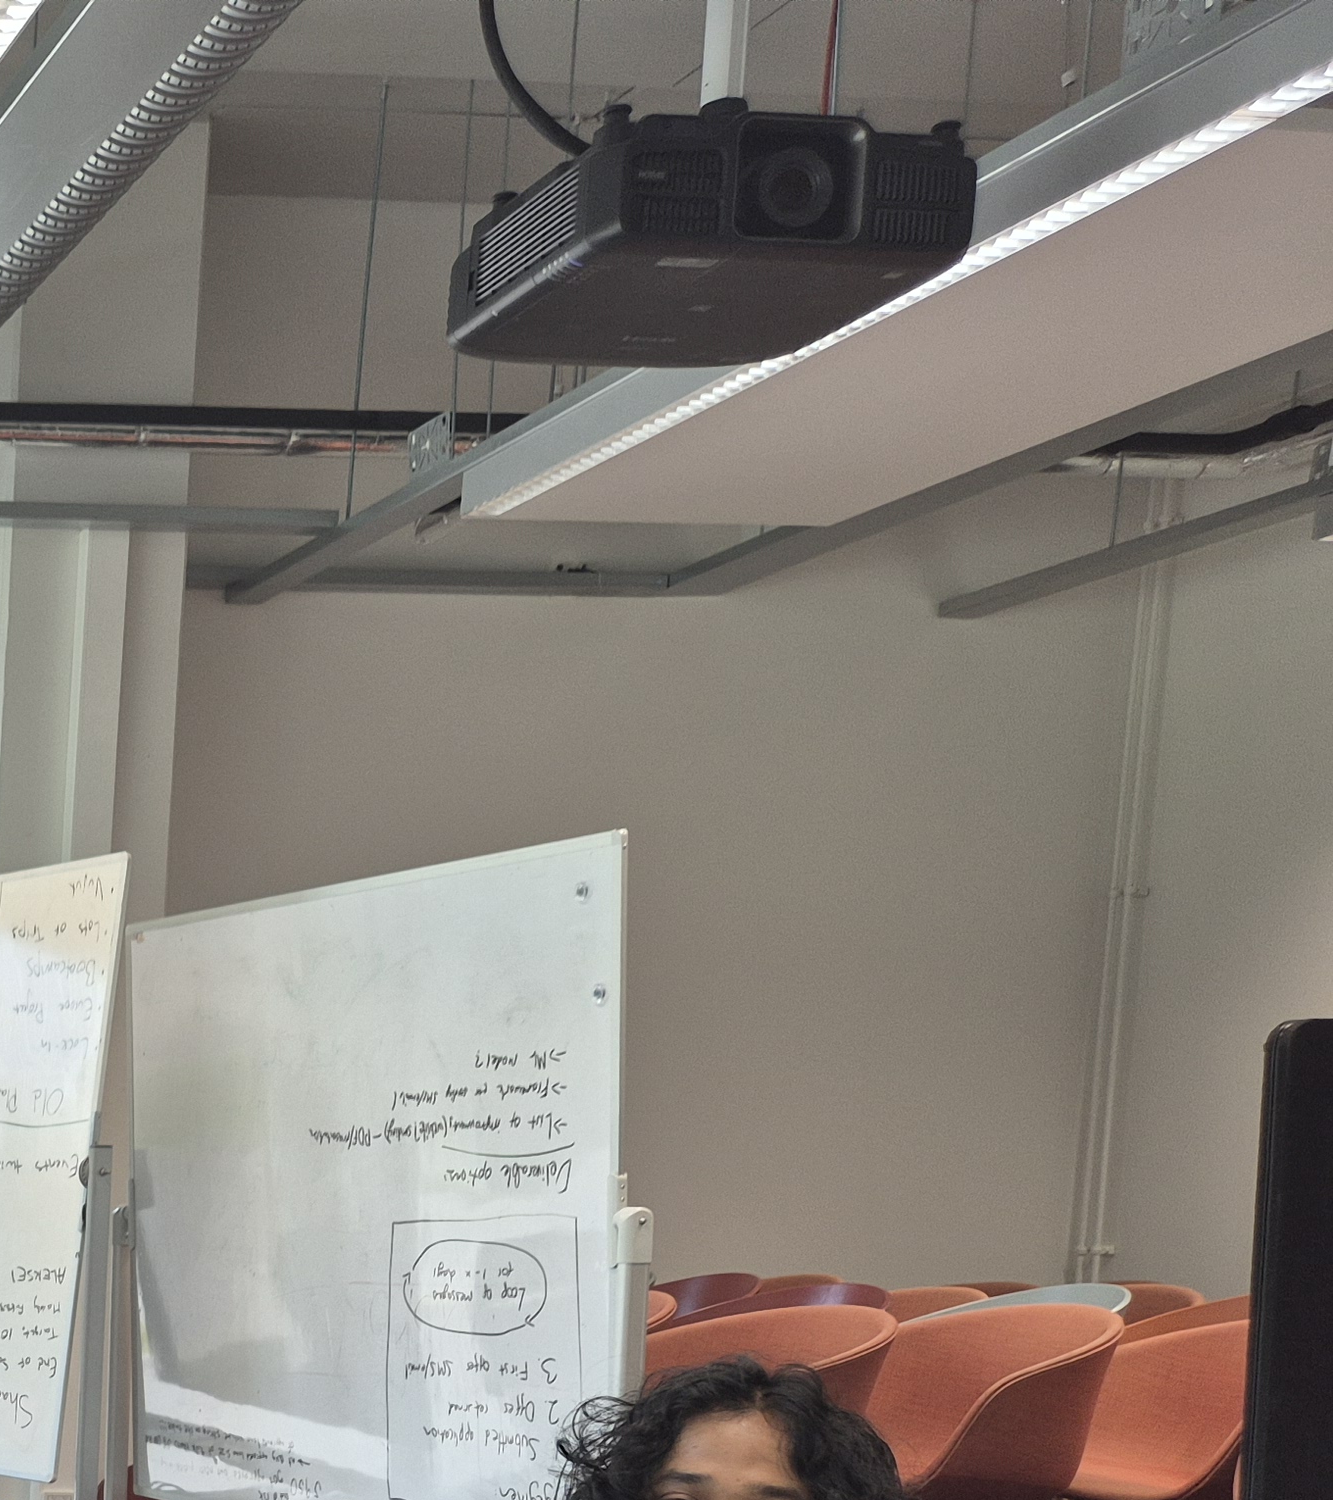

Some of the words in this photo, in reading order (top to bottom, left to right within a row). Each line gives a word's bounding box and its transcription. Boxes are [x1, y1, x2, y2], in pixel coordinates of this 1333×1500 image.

[27, 950, 96, 986] Bootcamps
[32, 1088, 63, 1116] Old
[11, 1266, 66, 1283] ALEKSEI
